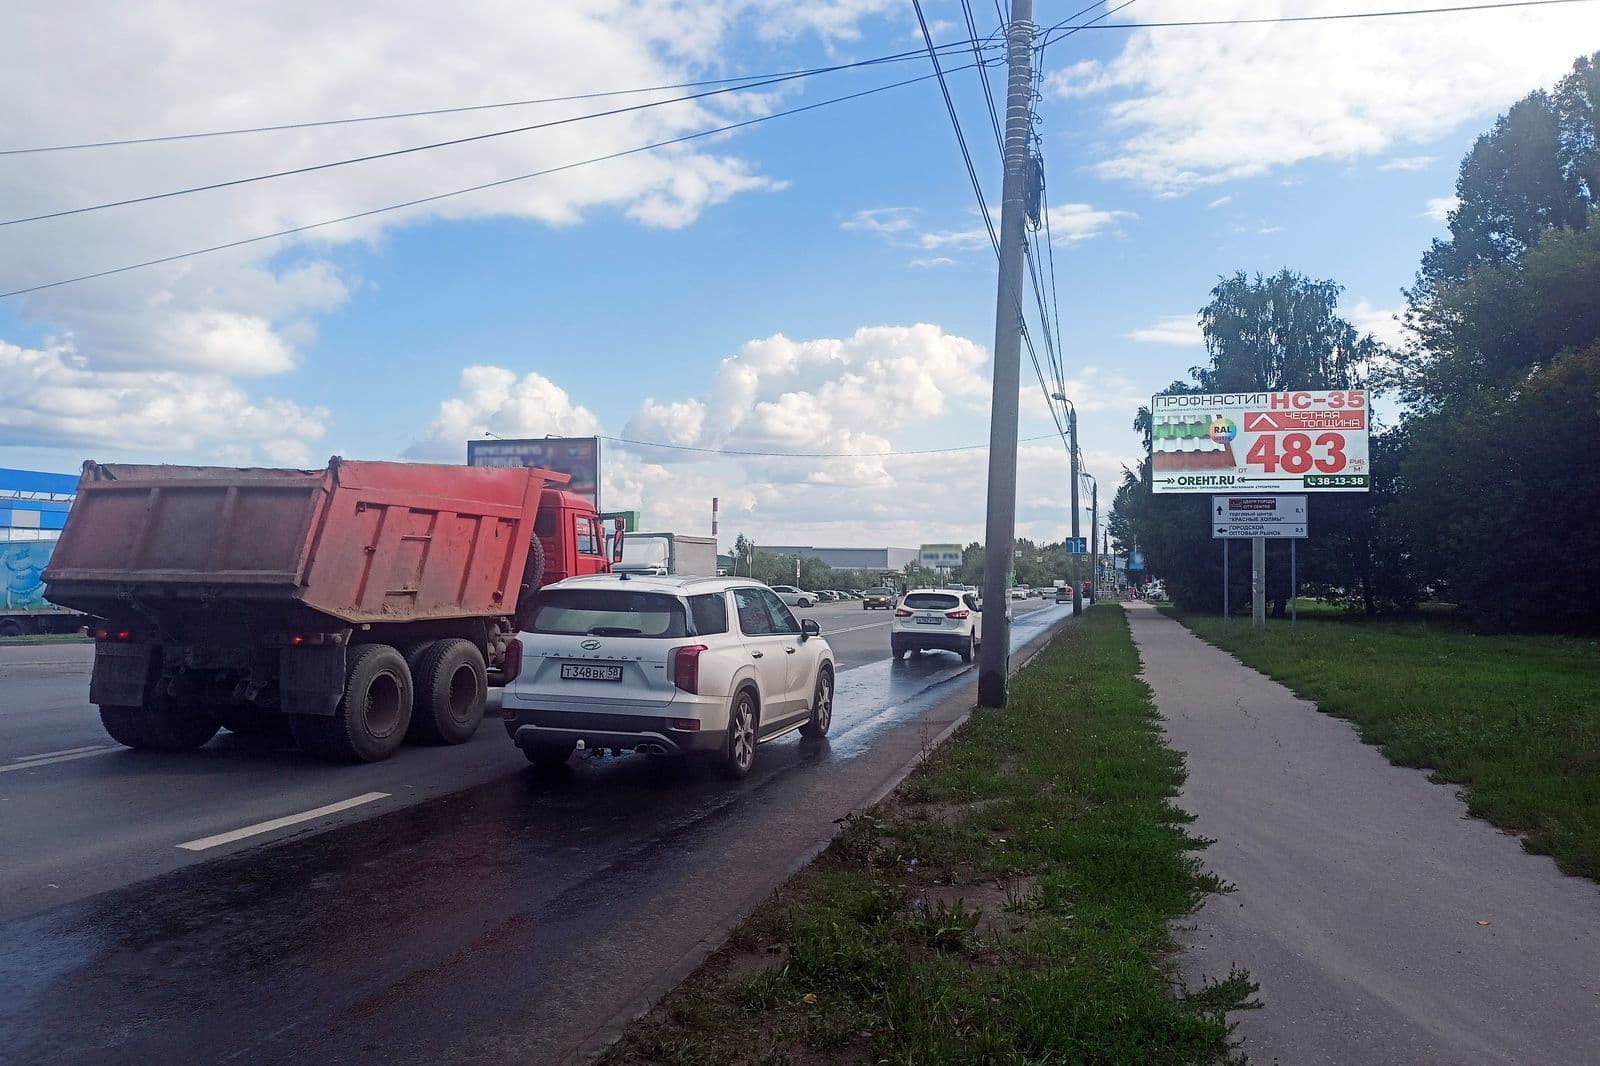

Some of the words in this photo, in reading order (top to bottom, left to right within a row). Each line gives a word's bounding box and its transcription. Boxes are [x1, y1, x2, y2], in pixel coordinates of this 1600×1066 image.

[1156, 394, 1268, 407] ПРОФНАСТИЛ
[1271, 391, 1364, 409] НС-35
[1284, 411, 1340, 420] ЧЕСТНАЯ
[1302, 419, 1360, 428] ТОЛЩИНА
[1246, 432, 1346, 474] 483
[1178, 476, 1234, 485] OREHT.RU
[608, 668, 618, 676] 58
